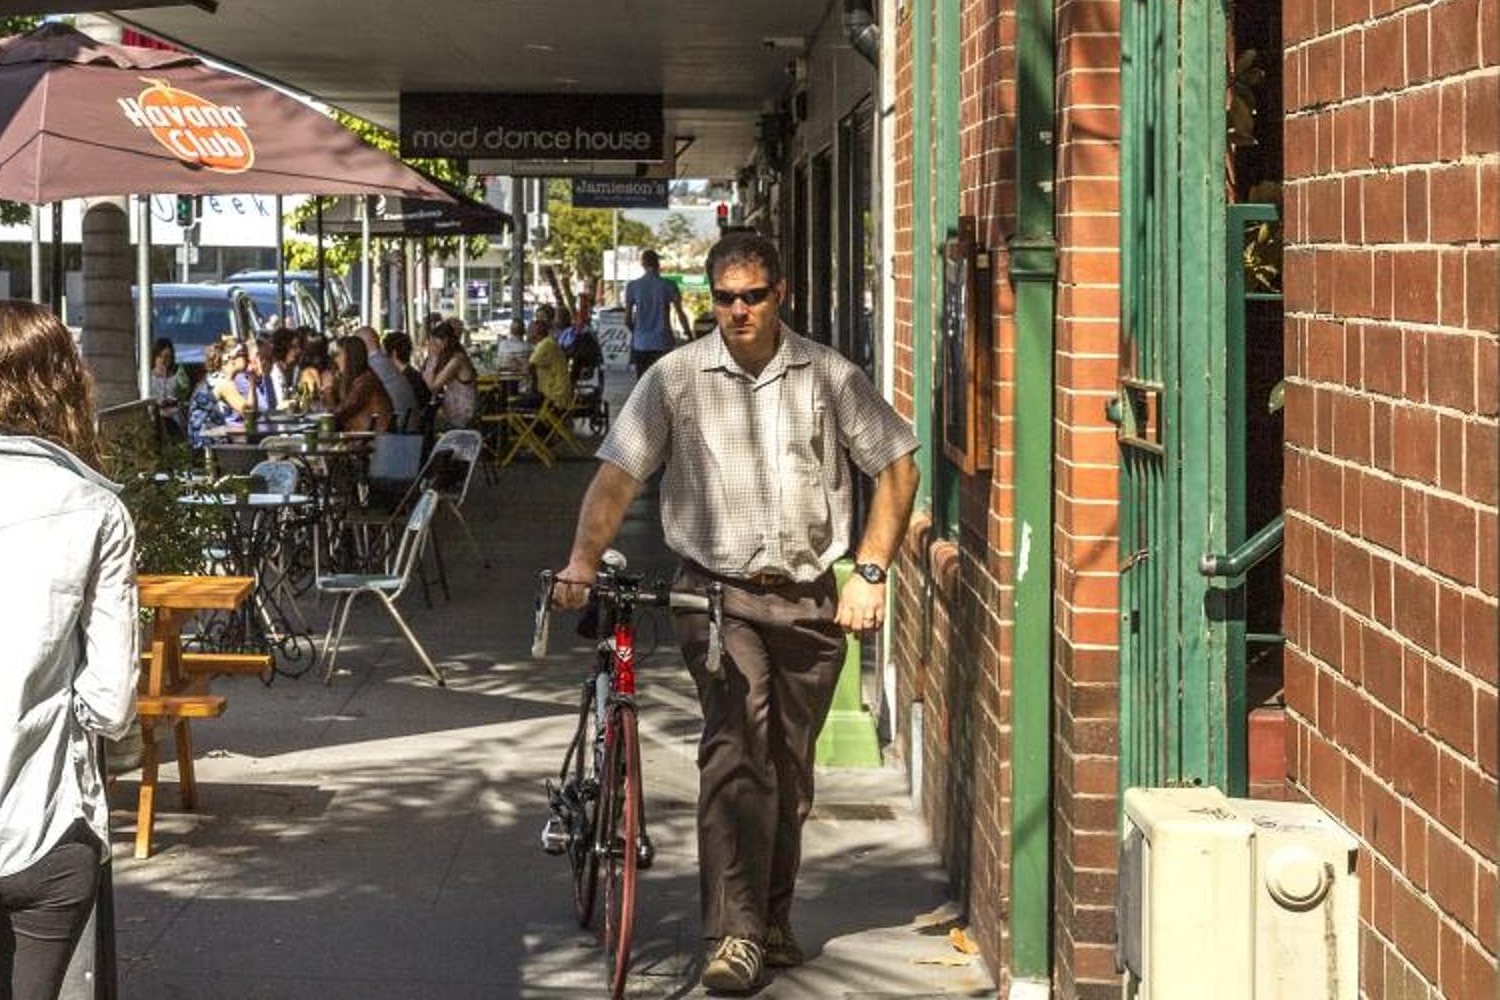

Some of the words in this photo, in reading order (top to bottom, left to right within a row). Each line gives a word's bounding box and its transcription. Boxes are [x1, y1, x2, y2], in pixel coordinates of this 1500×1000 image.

[116, 97, 248, 127] Havana
[168, 128, 245, 157] Club
[483, 126, 571, 150] dance
[575, 126, 650, 150] house
